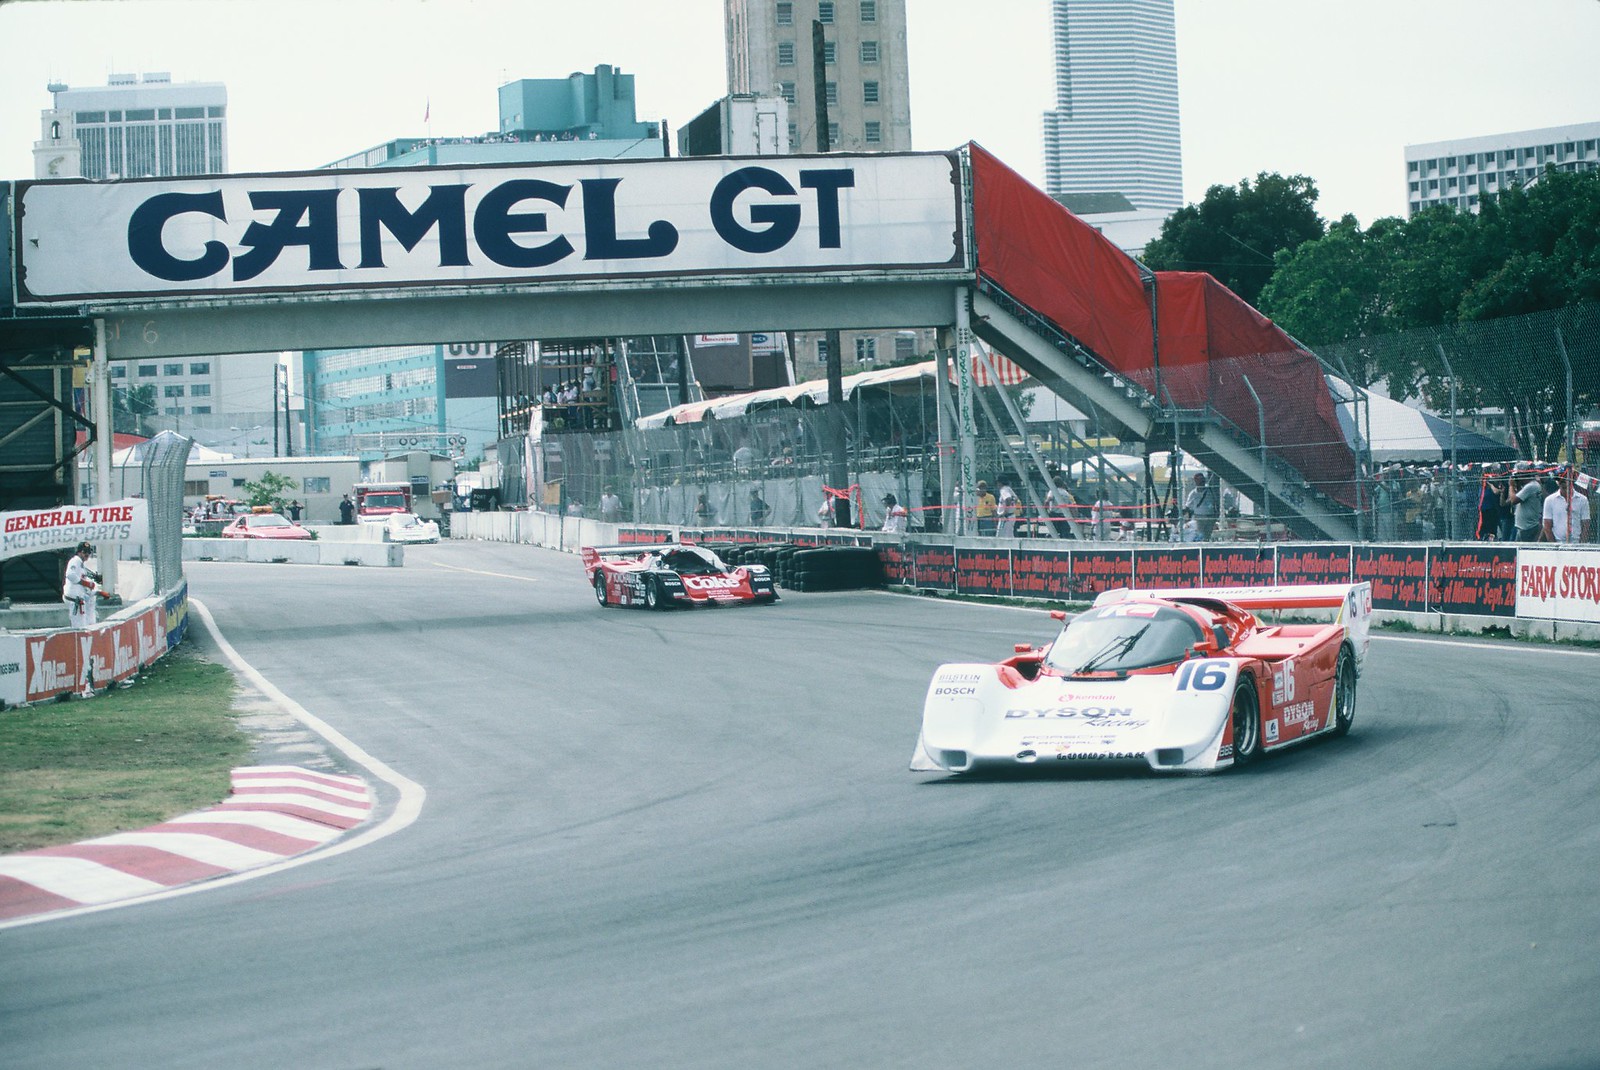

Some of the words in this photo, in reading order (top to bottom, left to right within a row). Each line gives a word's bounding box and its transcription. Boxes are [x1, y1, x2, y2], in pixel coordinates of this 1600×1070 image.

[128, 178, 679, 281] CAMEL
[710, 166, 854, 253] GT
[5, 511, 86, 533] GENERAL
[89, 506, 133, 523] TIRE
[3, 524, 131, 550] MOTORSPORTS
[683, 576, 741, 590] Coke
[1520, 565, 1556, 602] FARM
[1176, 661, 1231, 691] 16
[1283, 660, 1295, 702] 16
[935, 687, 976, 695] BOSCH
[1004, 707, 1133, 720] DYSON
[1082, 715, 1149, 730] Racing
[1283, 700, 1315, 723] DYSON
[1218, 743, 1234, 757] BBS
